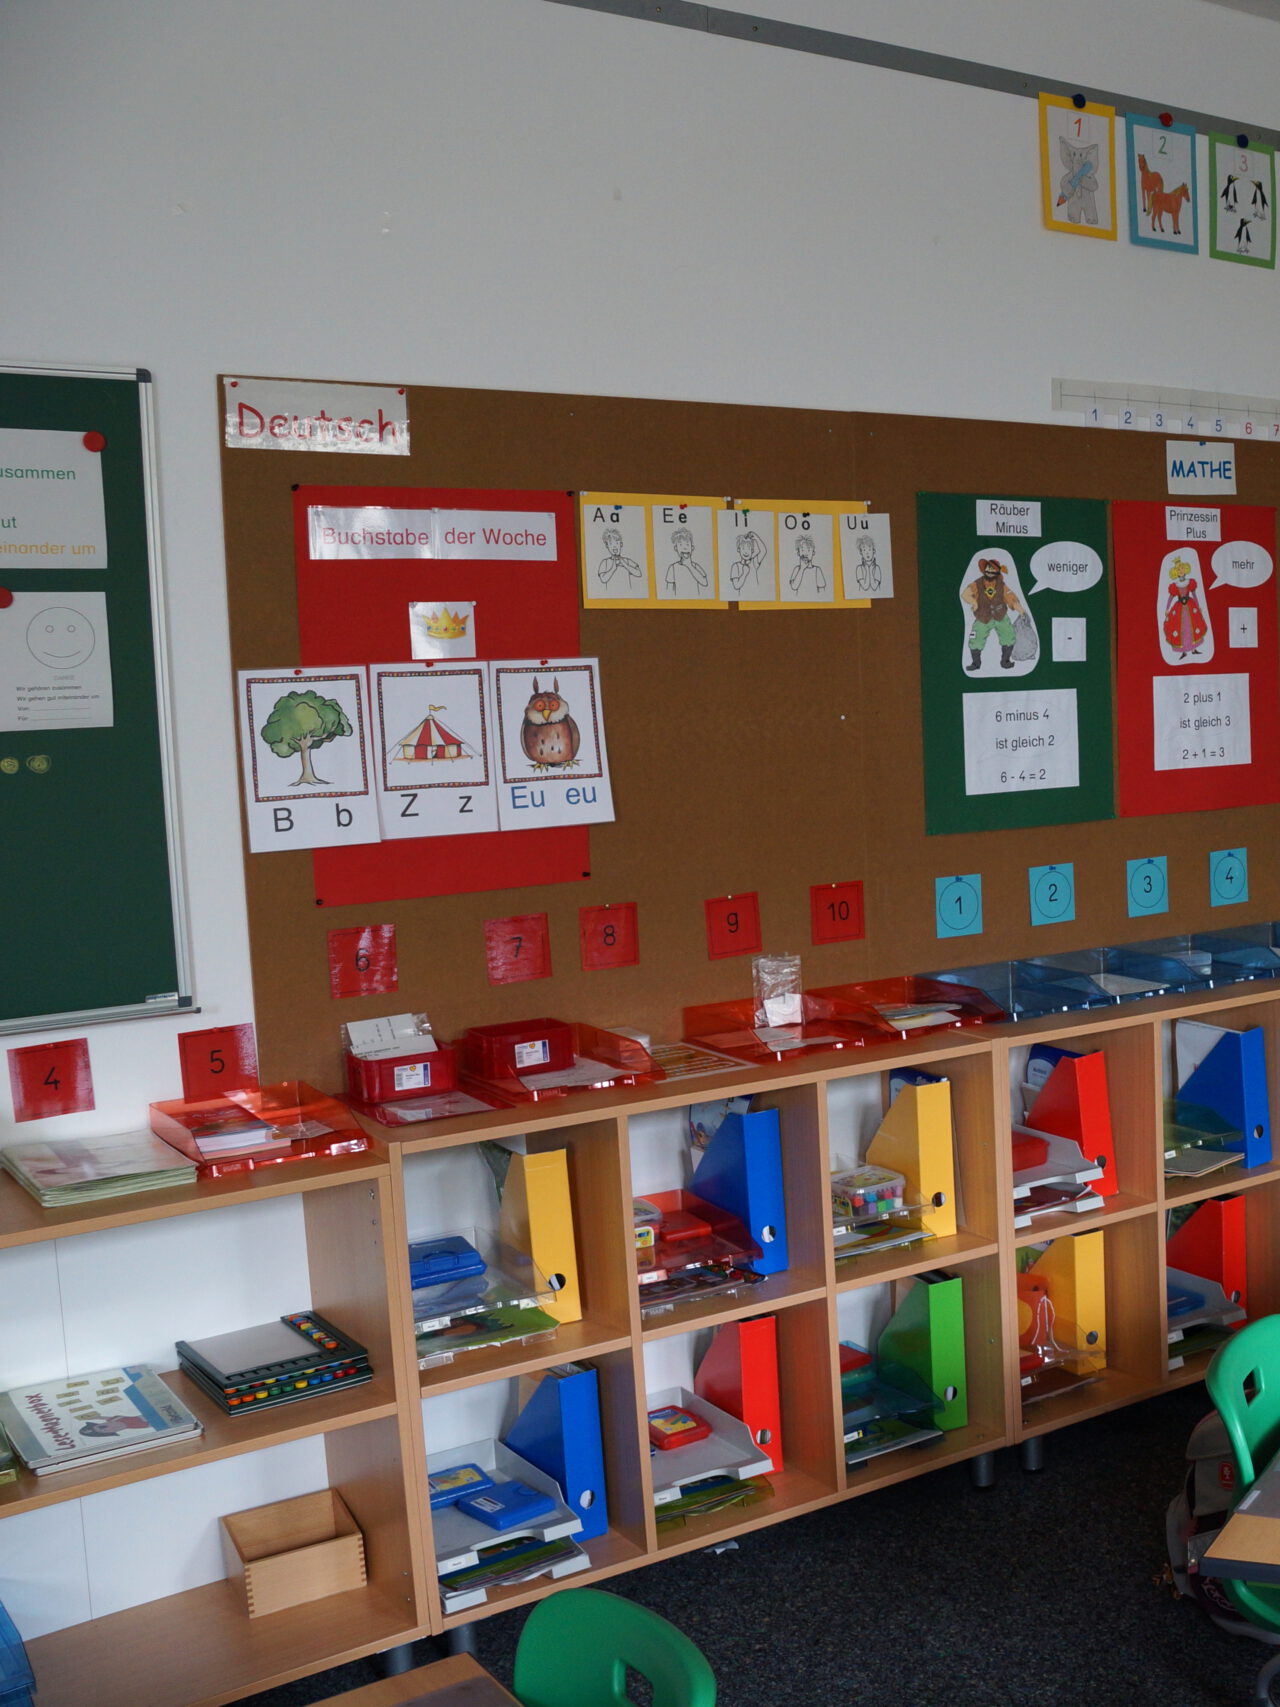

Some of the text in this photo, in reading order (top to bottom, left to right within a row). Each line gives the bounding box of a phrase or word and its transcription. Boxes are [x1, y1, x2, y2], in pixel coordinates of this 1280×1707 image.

[1074, 117, 1082, 137] 1
[1159, 136, 1168, 155] 2
[1239, 153, 1249, 172] 3
[238, 401, 398, 444] Deutsch
[1092, 408, 1222, 433] 1 2 3 4 5
[1170, 460, 1233, 480] MATHE
[593, 507, 620, 524] A a
[662, 507, 688, 524] E e
[989, 503, 1030, 517] Räuber
[1169, 509, 1218, 523] Prinzessin
[846, 516, 869, 530] U u
[995, 521, 1029, 535] Minus
[1185, 526, 1207, 539] Plus
[321, 526, 547, 546] Buchstabe der Woche
[70, 544, 96, 555] um
[1047, 559, 1088, 575] weniger
[1232, 558, 1255, 571] mehr
[1183, 691, 1222, 706] 2 plus 1
[995, 708, 1050, 723] 6 minus 4
[1179, 715, 1231, 731] ist gleich 3
[995, 734, 1055, 752] ist gleich 2
[1182, 749, 1189, 760] 2
[1202, 748, 1207, 759] 1
[1219, 747, 1225, 758] 3
[1000, 771, 1007, 784] 6
[1018, 771, 1026, 782] 4
[1039, 769, 1046, 781] 2
[400, 793, 474, 818] Z z
[511, 785, 597, 810] Eu eu
[272, 803, 354, 833] B b
[1143, 875, 1153, 894] 3
[1225, 867, 1234, 884] 4
[1048, 883, 1058, 902] 2
[827, 901, 850, 921] 10
[954, 896, 962, 915] 1
[727, 912, 739, 933] 9
[603, 925, 616, 946] 8
[510, 936, 523, 958] 7
[355, 947, 370, 972] 6
[209, 1049, 225, 1074] 5
[44, 1066, 60, 1091] 4
